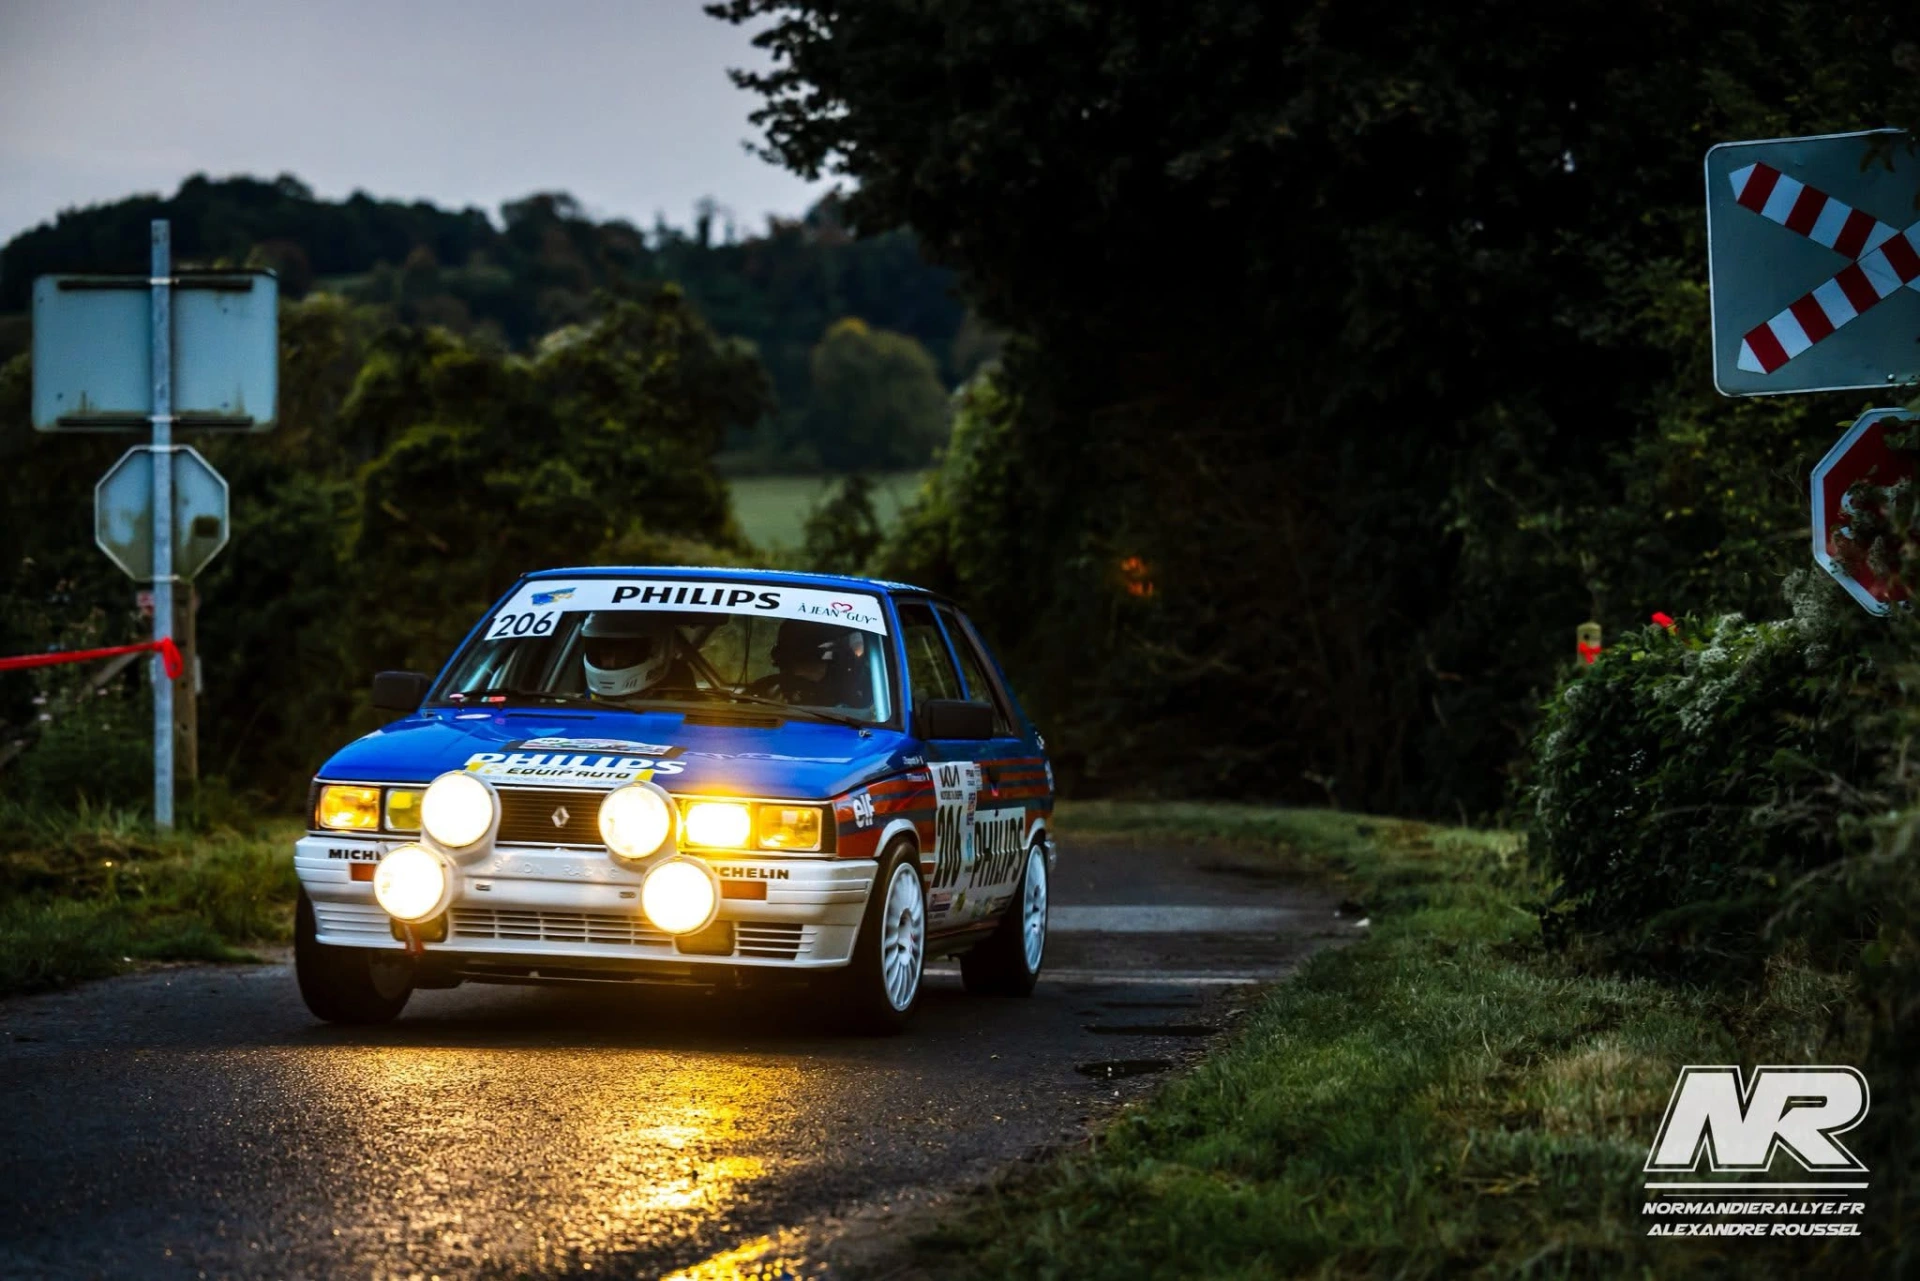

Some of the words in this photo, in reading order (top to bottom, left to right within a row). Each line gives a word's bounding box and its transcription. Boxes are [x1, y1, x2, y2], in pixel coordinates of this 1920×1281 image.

[611, 586, 781, 610] PHILIPS
[810, 606, 840, 618] JEAN
[492, 611, 554, 638] 206
[464, 752, 687, 775] PHILIPS
[853, 793, 875, 829] elf
